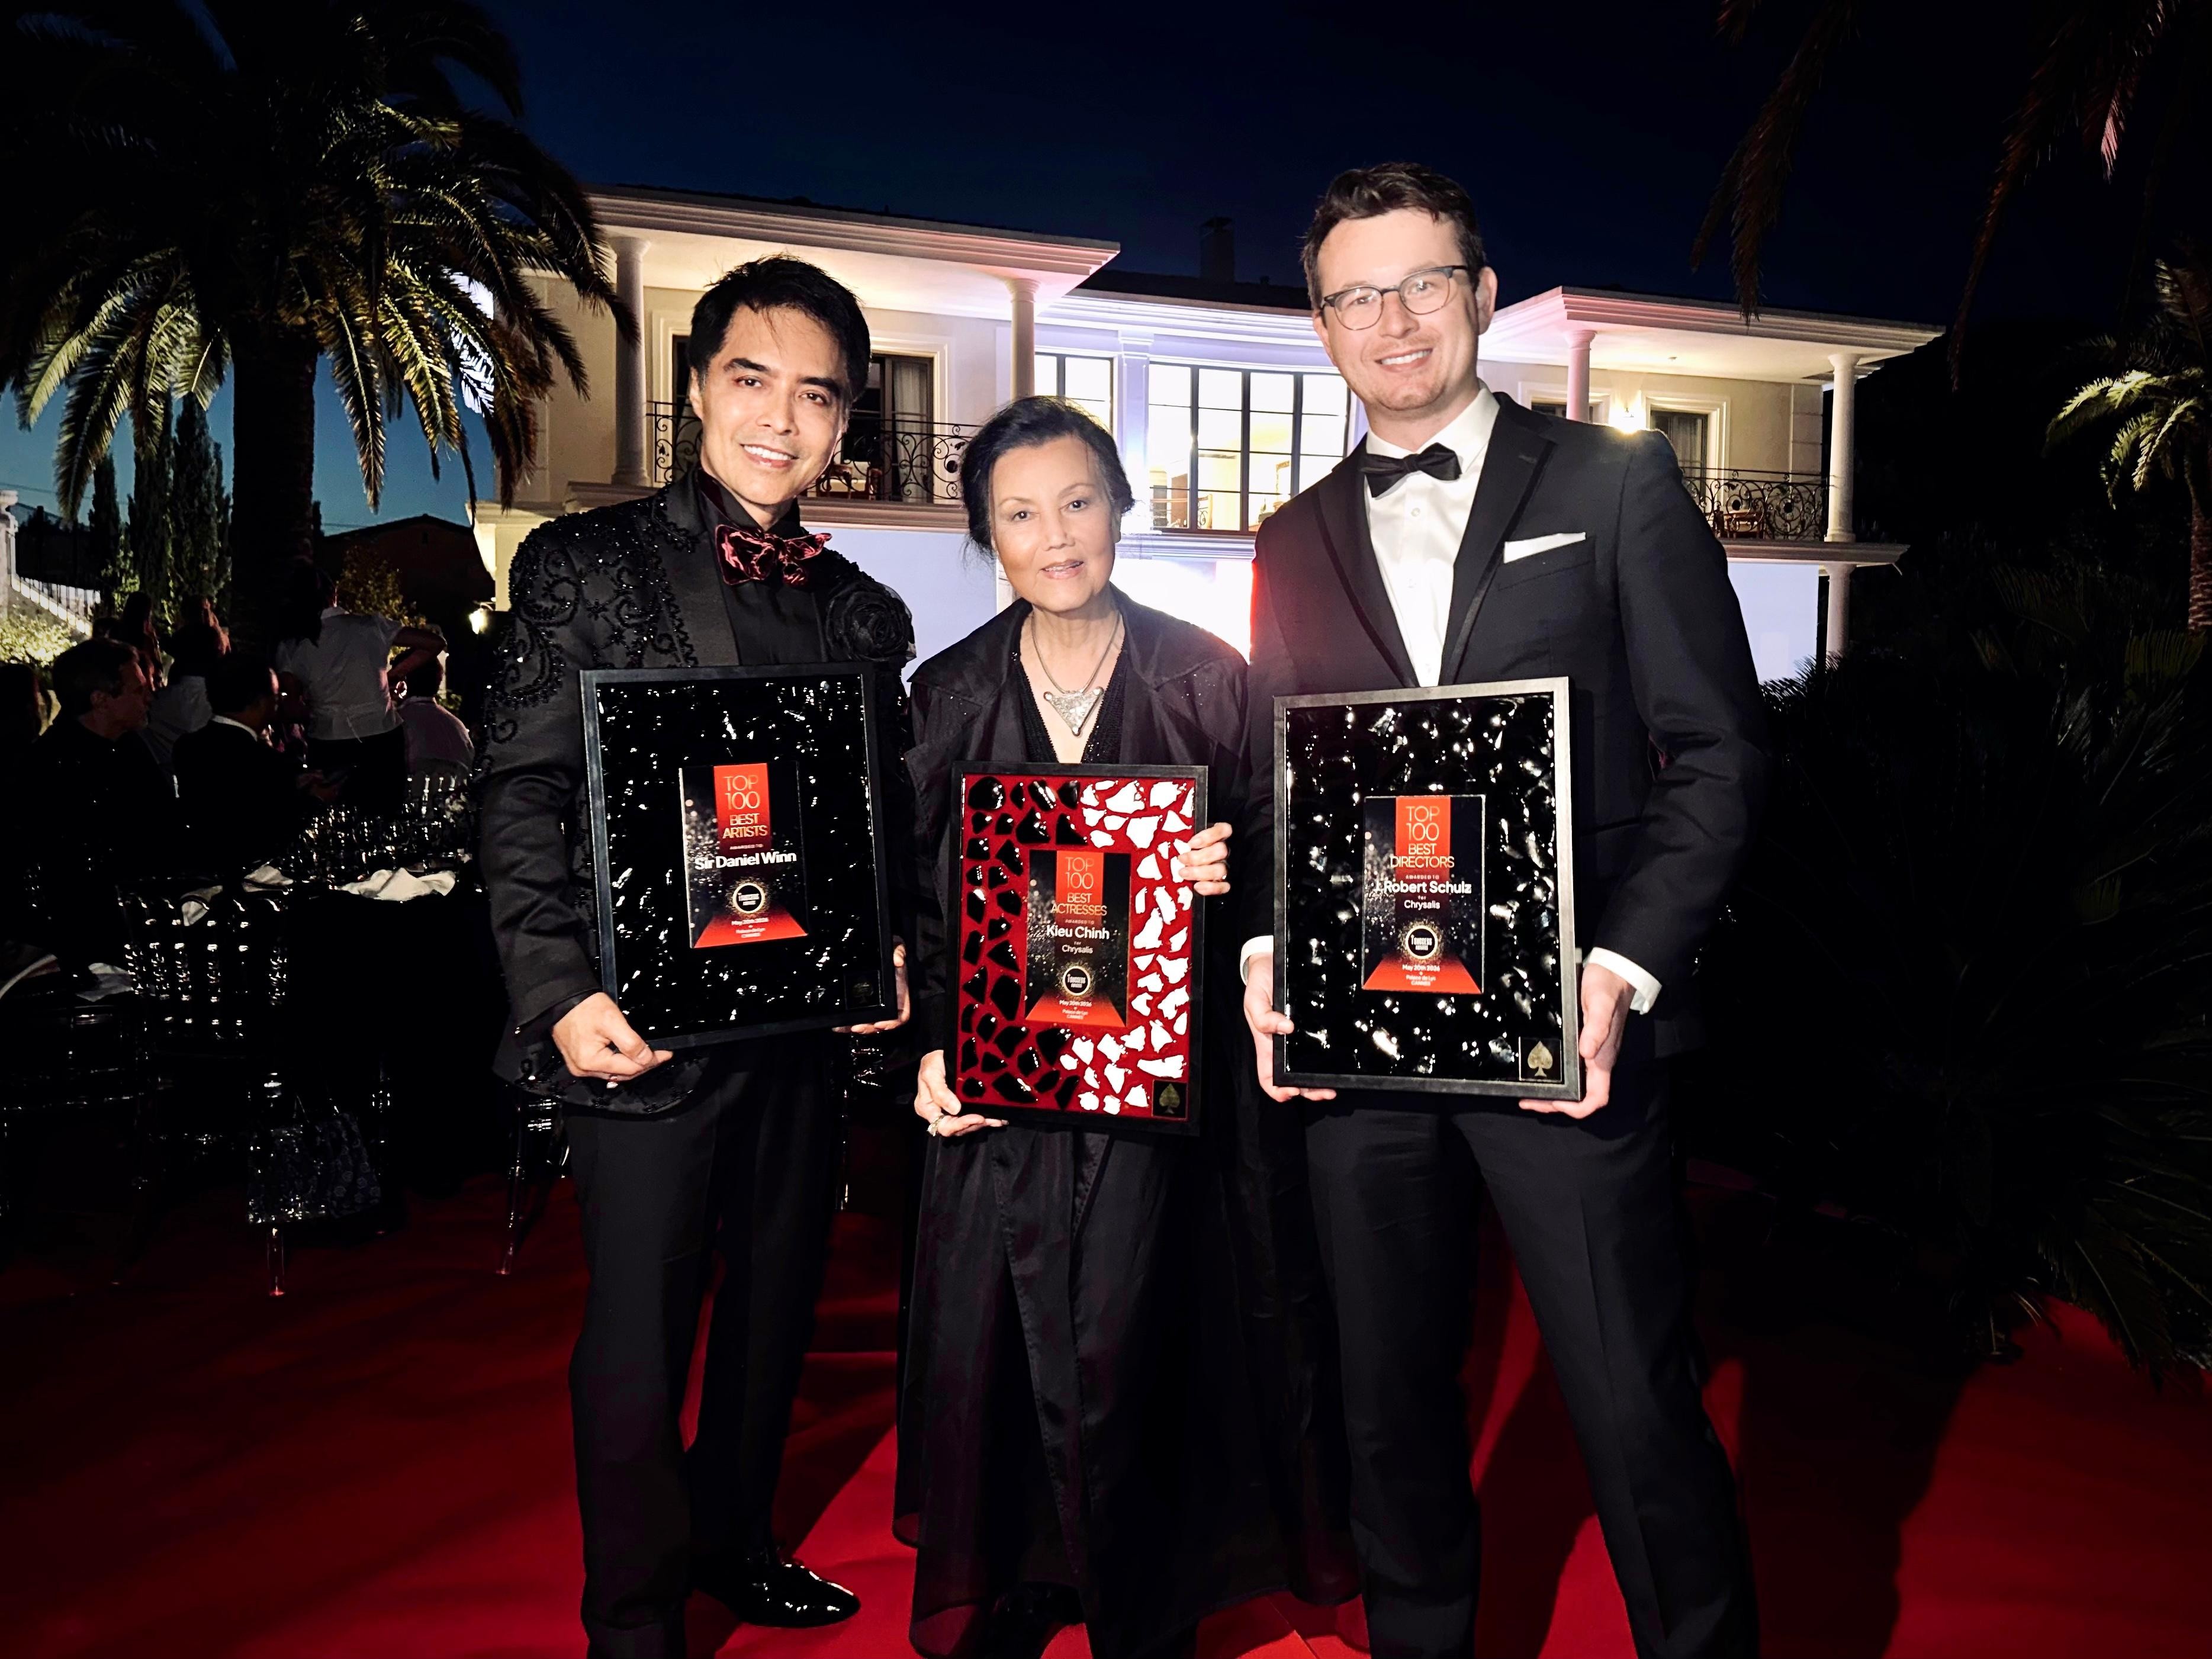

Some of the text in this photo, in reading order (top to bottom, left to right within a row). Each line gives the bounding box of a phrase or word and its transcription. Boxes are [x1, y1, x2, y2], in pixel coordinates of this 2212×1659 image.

[723, 774, 758, 791] TOP
[724, 791, 760, 810] 100
[729, 813, 760, 825] BEST
[1406, 806, 1439, 822] TOP
[722, 825, 768, 838] ARTISTS
[1406, 822, 1439, 841] 100
[1409, 843, 1437, 855] BEST
[695, 851, 797, 870] Sir Daniel Winn
[1065, 857, 1094, 872] TOP
[1390, 856, 1455, 868] DIRECTORS
[1065, 872, 1094, 889] 100
[1384, 880, 1427, 893] Robert
[1429, 880, 1472, 893] Schulz
[1067, 892, 1092, 903] BEST
[1050, 903, 1108, 916] ACTRESSES
[1404, 899, 1441, 911] Chrysalis
[1046, 924, 1110, 940] Kieu Chinh
[1062, 944, 1094, 954] Chrysalis
